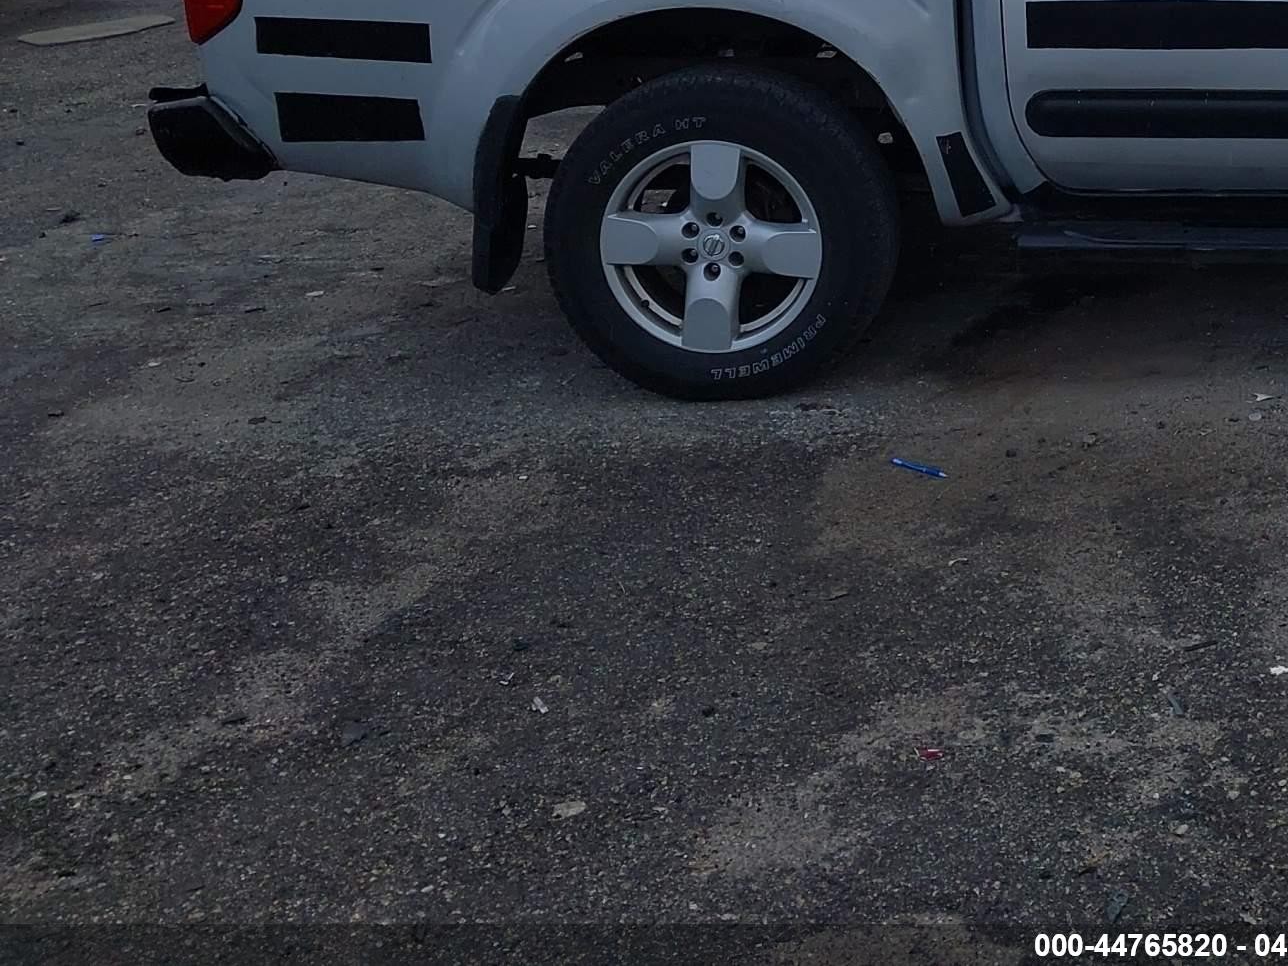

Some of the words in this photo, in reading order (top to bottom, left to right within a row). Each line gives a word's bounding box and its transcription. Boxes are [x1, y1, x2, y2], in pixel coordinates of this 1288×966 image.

[587, 123, 666, 185] VALERA
[674, 116, 706, 131] HT
[709, 313, 826, 380] PRIMEWELL
